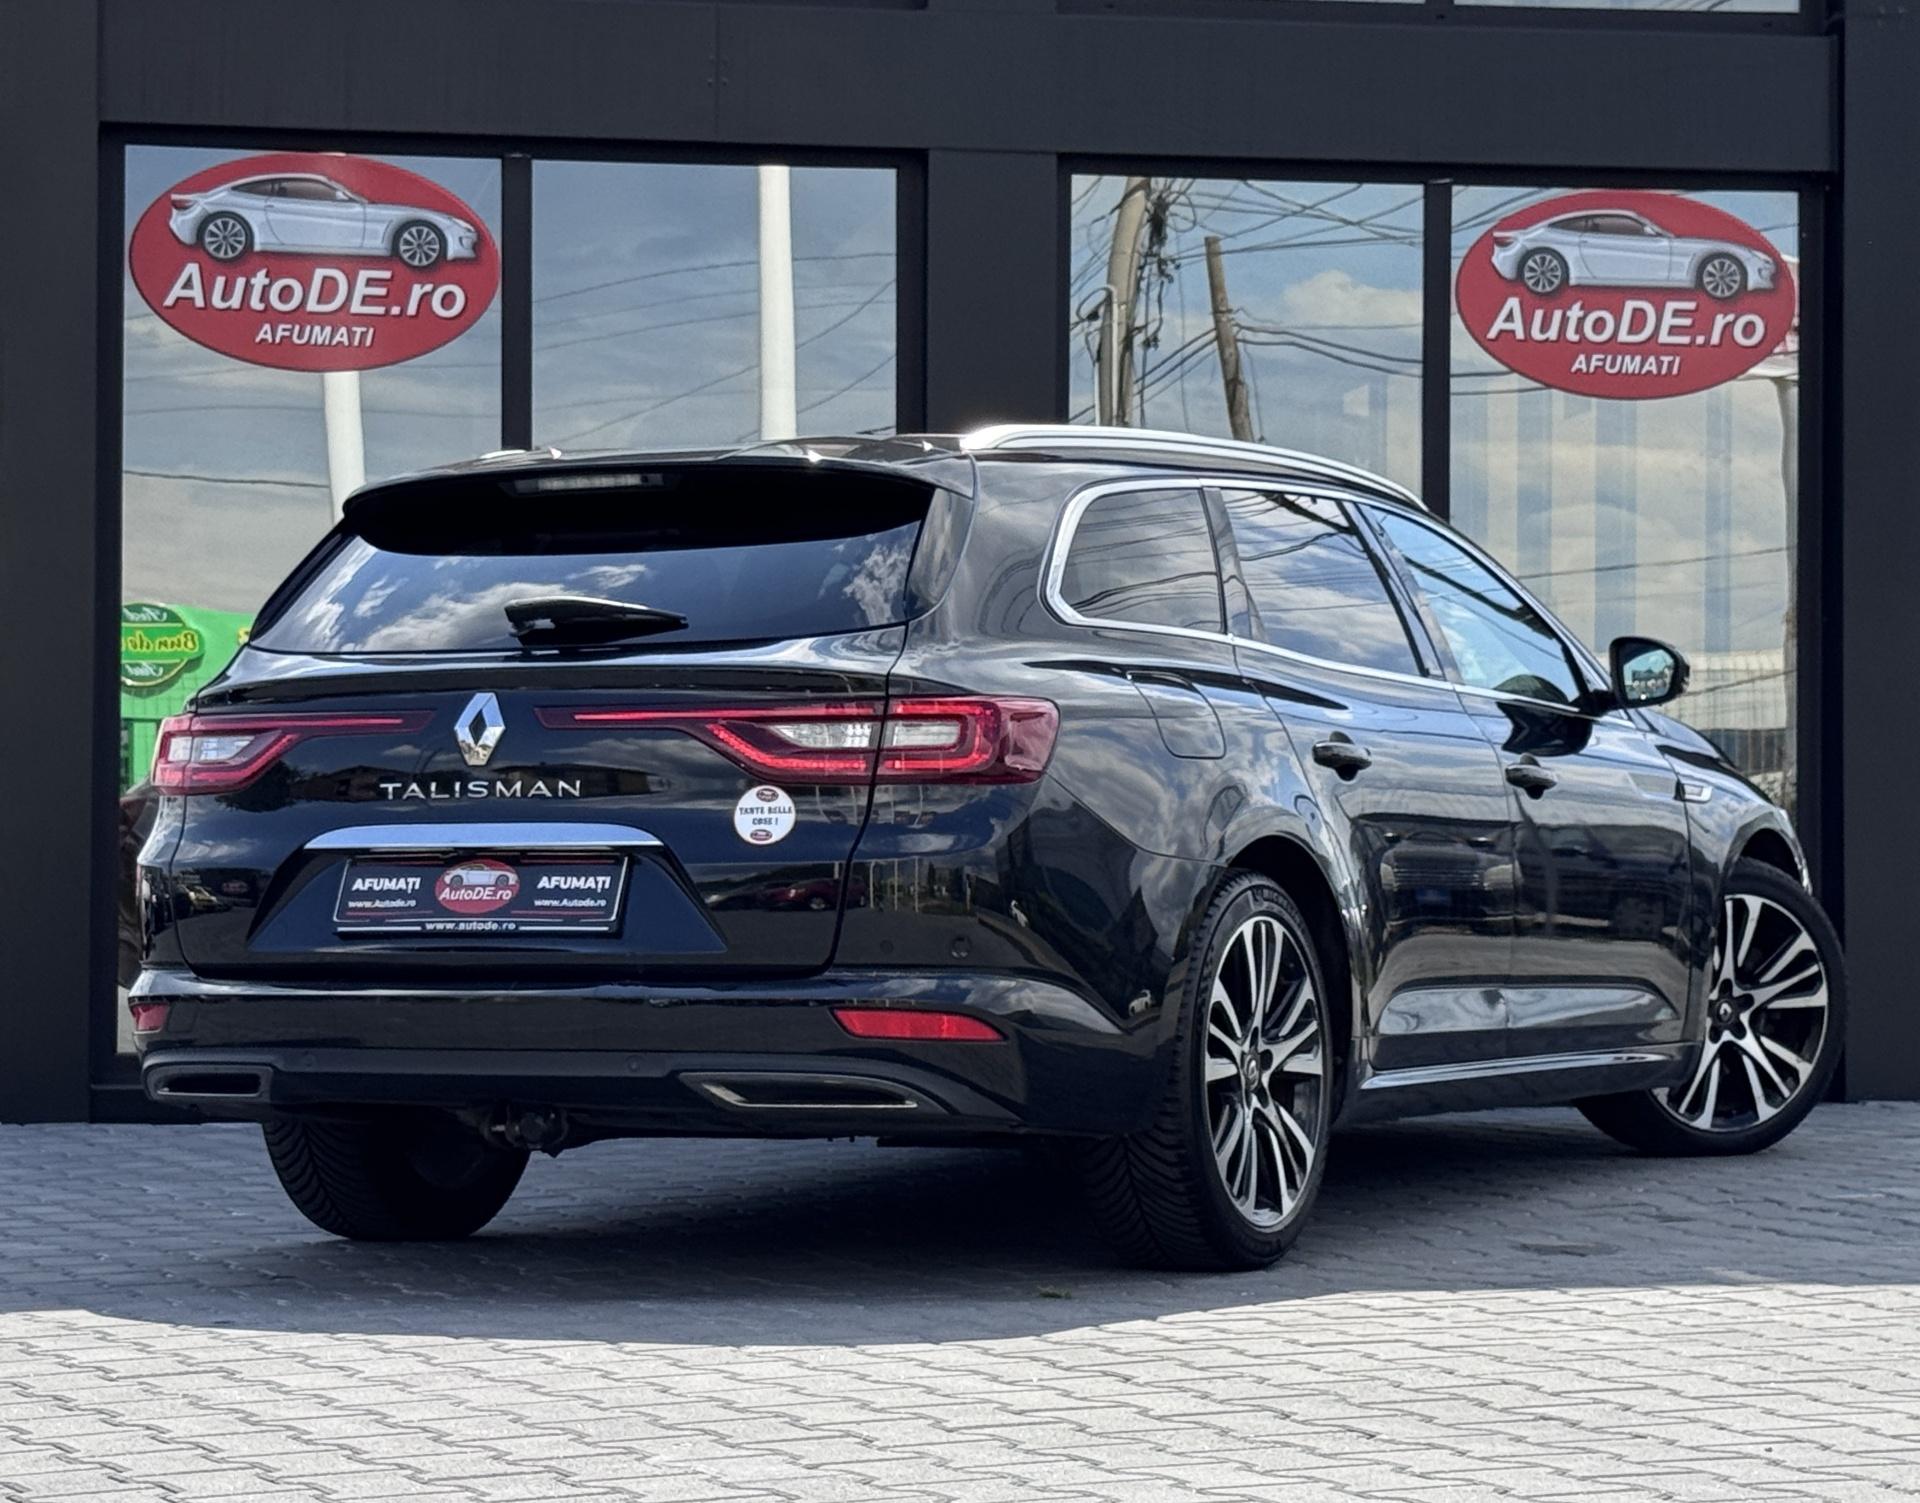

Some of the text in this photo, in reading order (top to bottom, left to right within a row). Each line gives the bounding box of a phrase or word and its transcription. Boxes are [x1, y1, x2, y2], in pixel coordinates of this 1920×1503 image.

[163, 262, 467, 320] AutoDE.ro
[1486, 296, 1767, 348] AutoDE.ro
[254, 322, 375, 348] AFUMATI
[1570, 353, 1681, 376] AFUMATI
[379, 779, 581, 800] TALISMAN
[439, 886, 513, 901] AutoDE.ro
[425, 920, 517, 932] www.autode.ro
